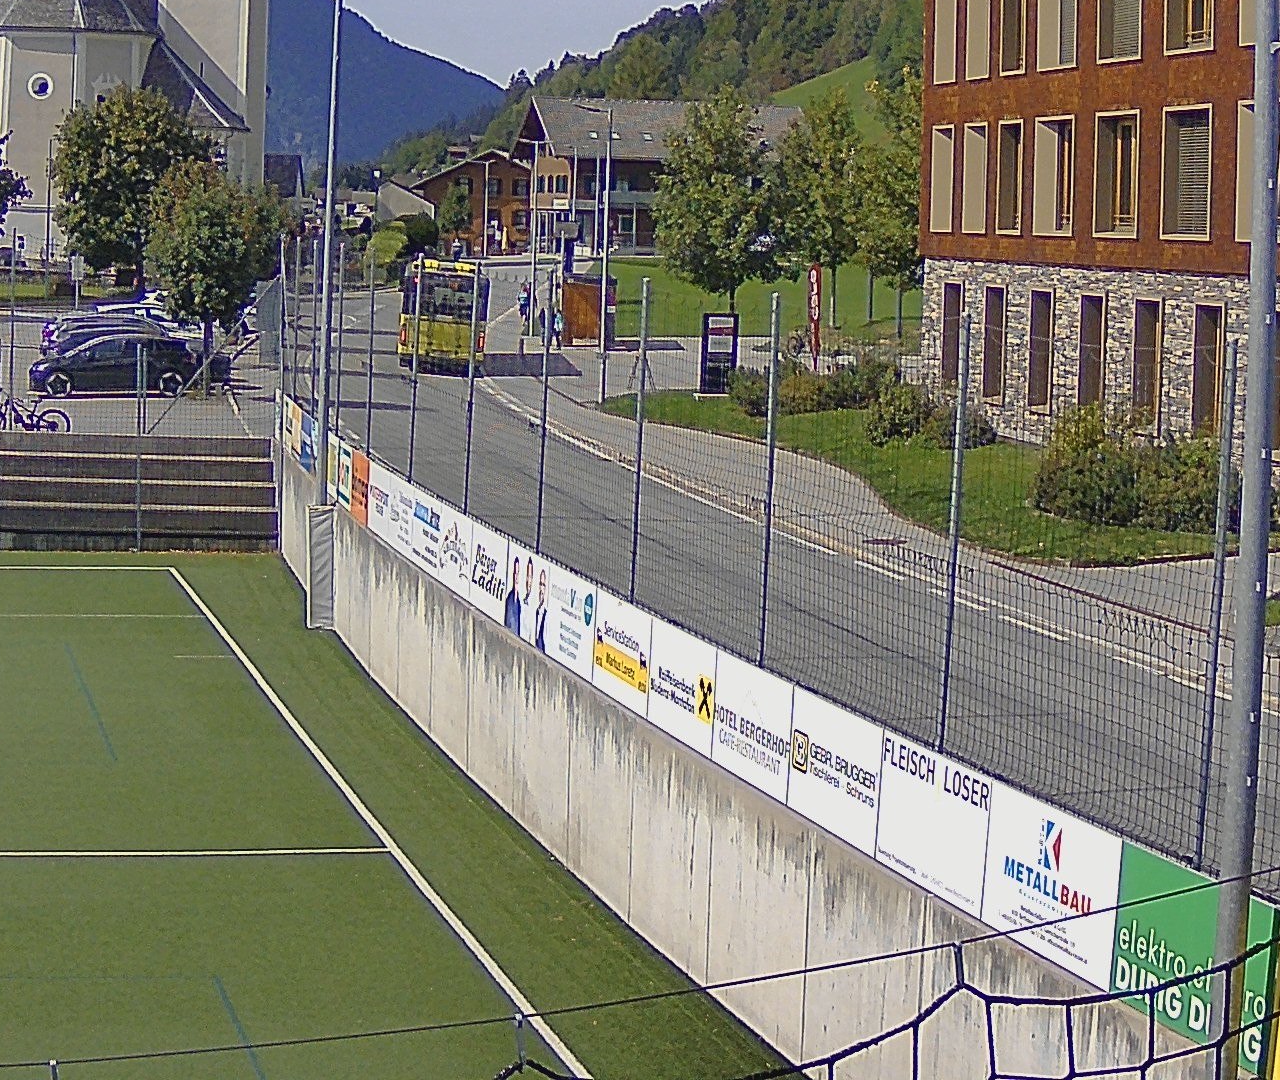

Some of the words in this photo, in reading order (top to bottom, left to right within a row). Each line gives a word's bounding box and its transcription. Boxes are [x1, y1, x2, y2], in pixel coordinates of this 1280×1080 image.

[714, 702, 737, 731] HOTEL
[739, 717, 791, 759] BERGERHOF
[846, 782, 874, 808] Schruns
[884, 737, 936, 785] FLEISCH
[943, 766, 990, 811] LOSER
[1004, 856, 1092, 917] METALLBAU
[1118, 919, 1187, 978] elektro
